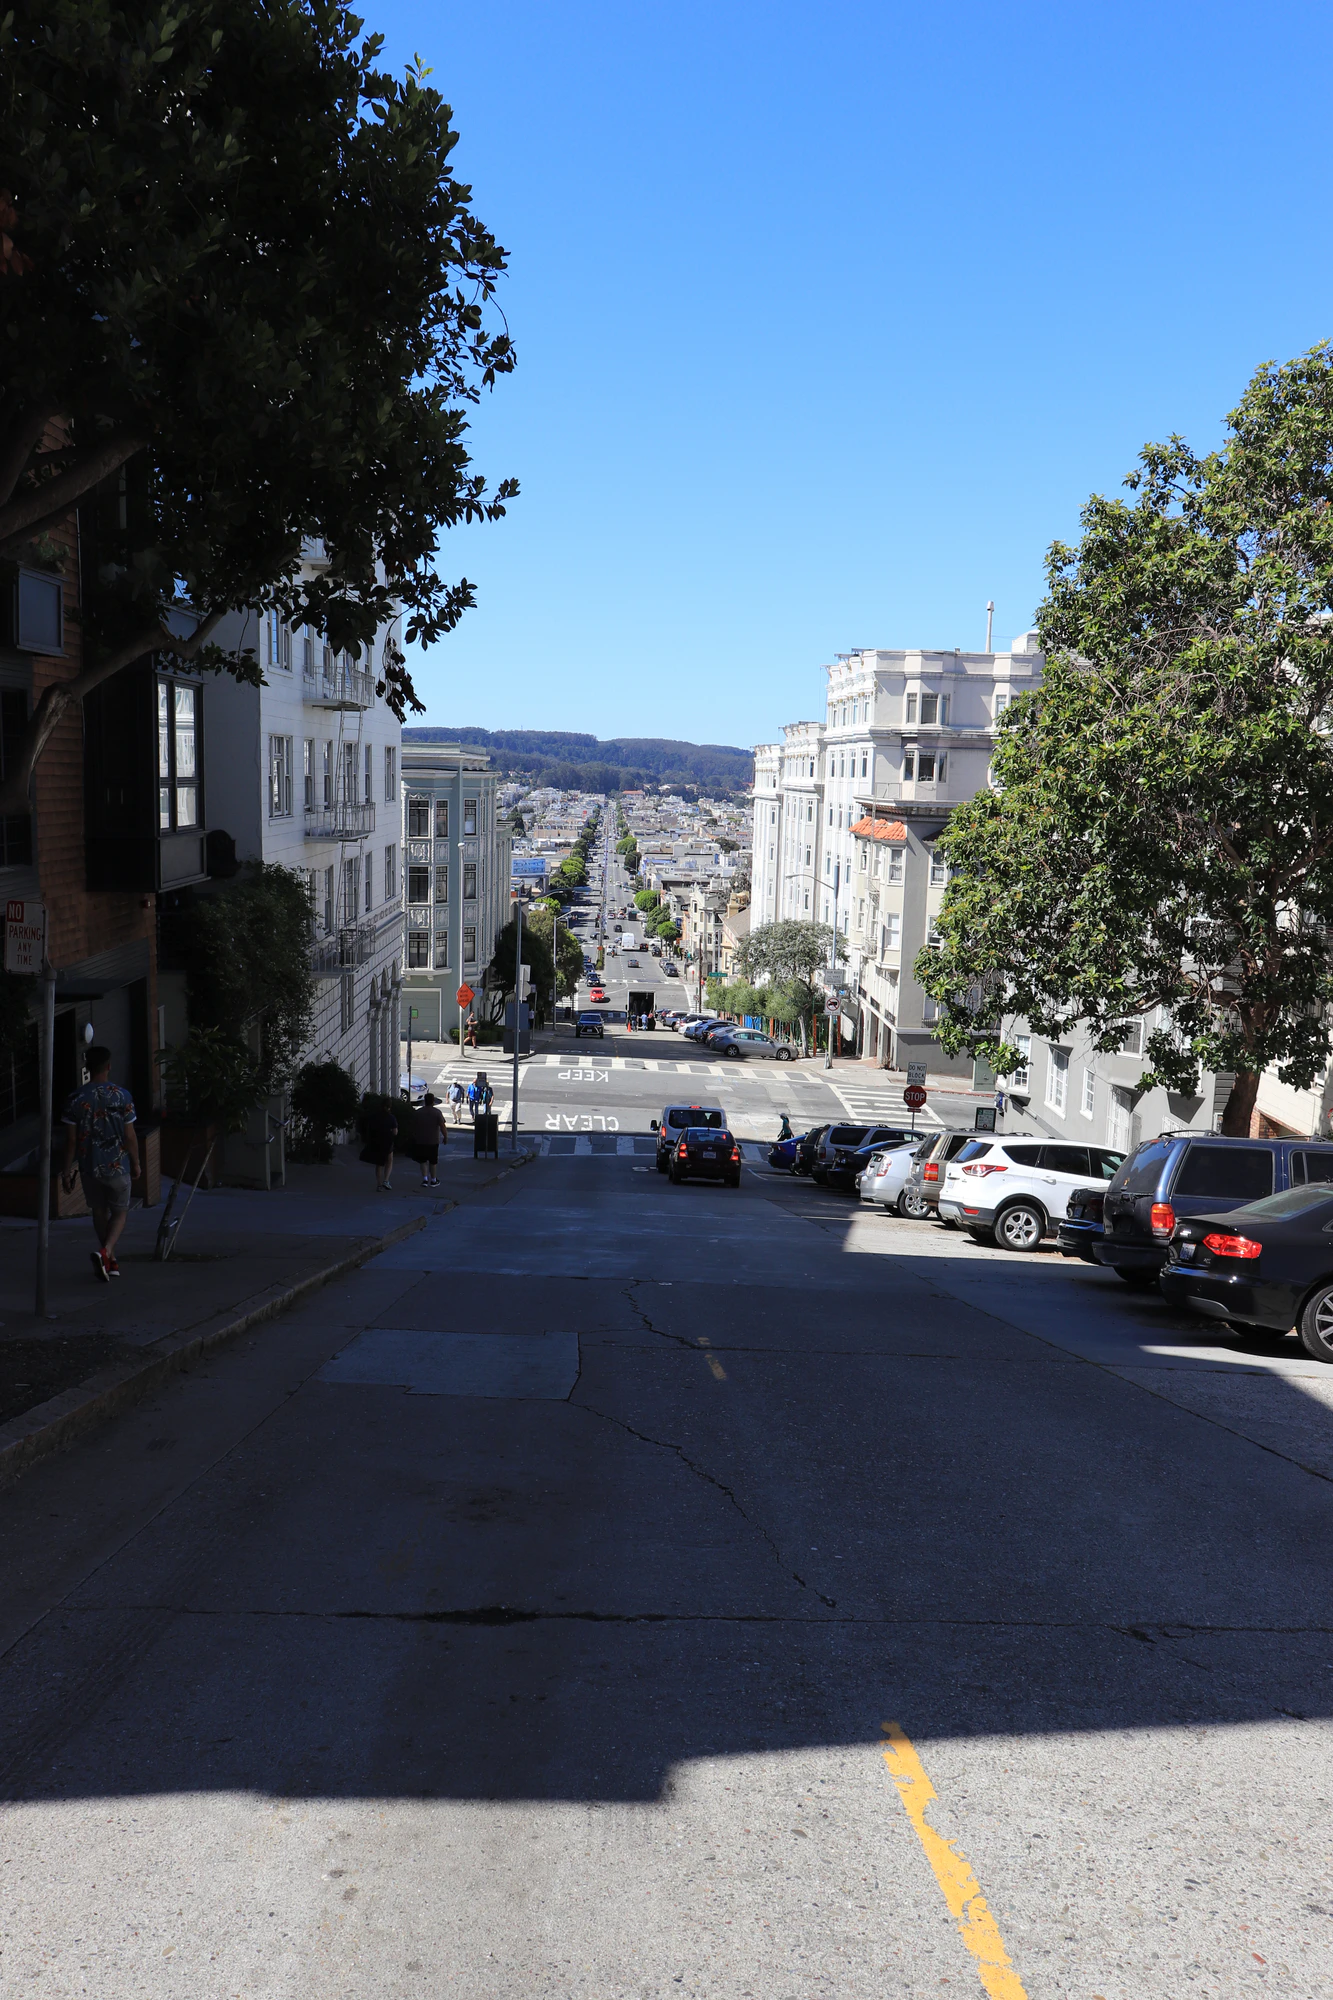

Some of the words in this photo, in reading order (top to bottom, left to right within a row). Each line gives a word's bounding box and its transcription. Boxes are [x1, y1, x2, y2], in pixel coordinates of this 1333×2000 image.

[8, 903, 22, 920] NO
[8, 925, 41, 941] PARKING
[17, 942, 32, 953] ANY
[17, 954, 32, 966] TIME
[558, 1069, 609, 1082] KEEP
[905, 1092, 925, 1102] STOP
[545, 1113, 619, 1131] CLEAR
